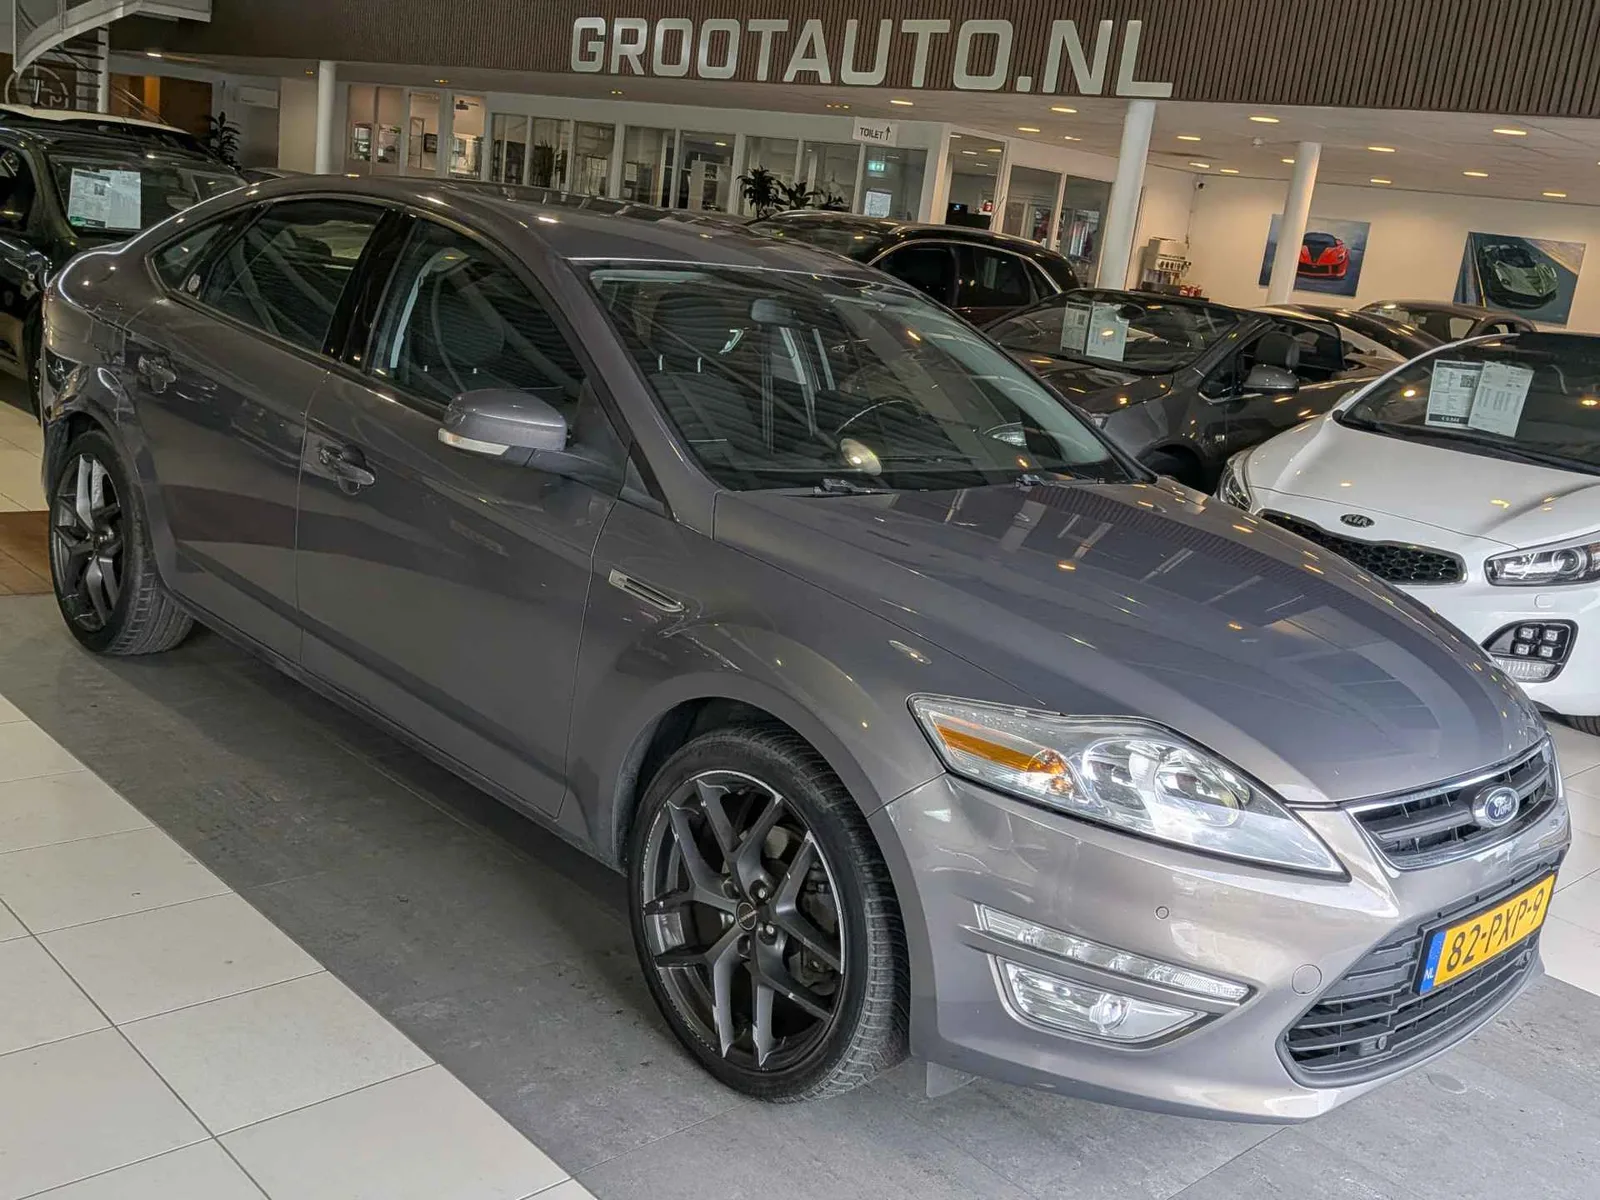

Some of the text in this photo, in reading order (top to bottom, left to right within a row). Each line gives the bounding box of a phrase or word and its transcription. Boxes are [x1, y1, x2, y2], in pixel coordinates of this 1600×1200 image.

[571, 17, 1173, 98] GROOTAUTO.NL
[860, 127, 884, 140] TOILET
[1446, 888, 1544, 972] 82-PXP-9
